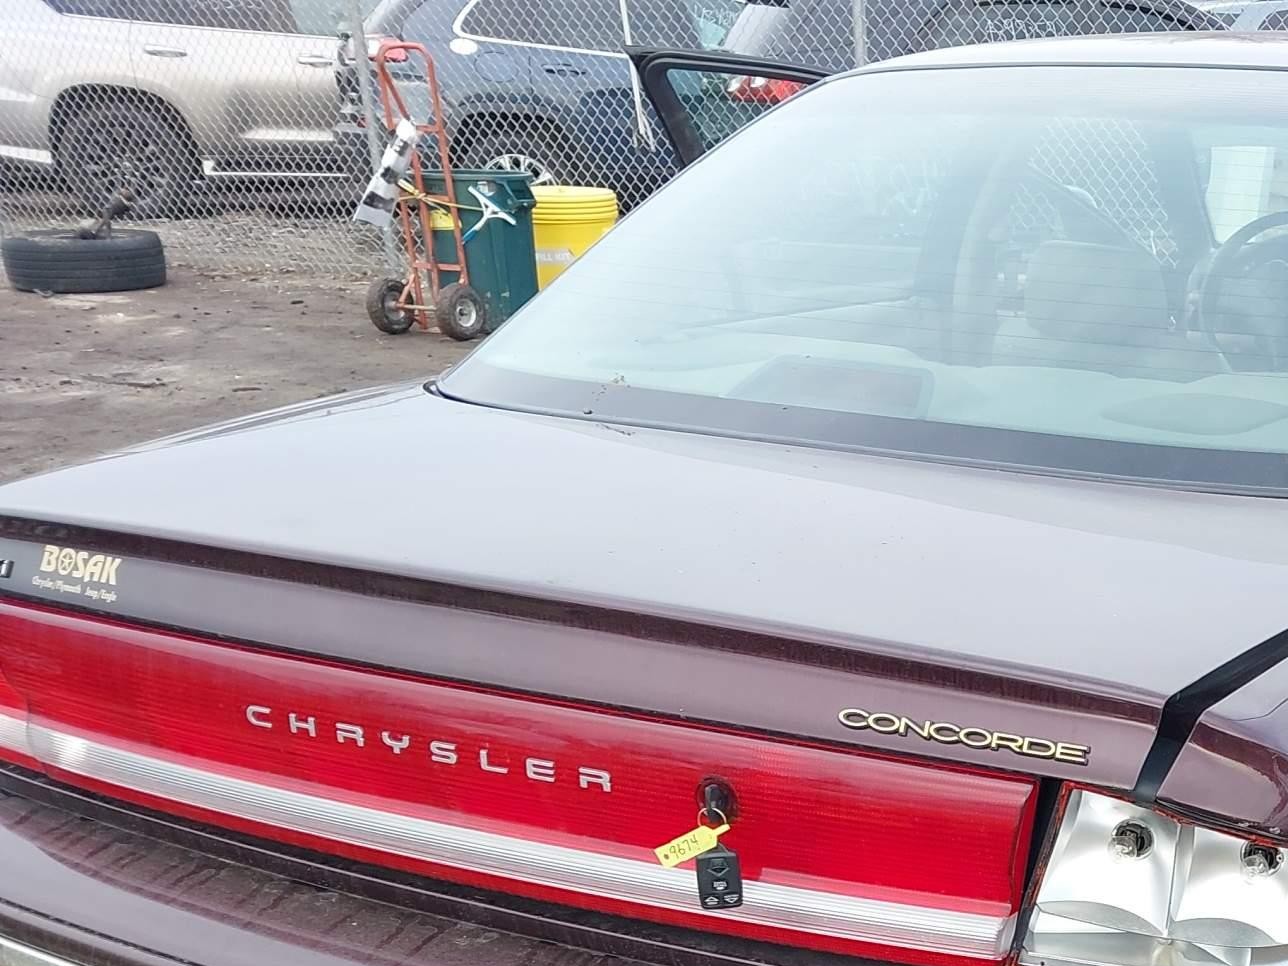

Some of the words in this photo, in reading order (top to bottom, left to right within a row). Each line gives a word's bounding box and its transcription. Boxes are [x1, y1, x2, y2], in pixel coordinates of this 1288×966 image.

[40, 544, 122, 585] BOSAK
[246, 704, 612, 793] CHRYSLER
[838, 708, 1091, 765] CONCORDE
[669, 834, 699, 859] 9674
